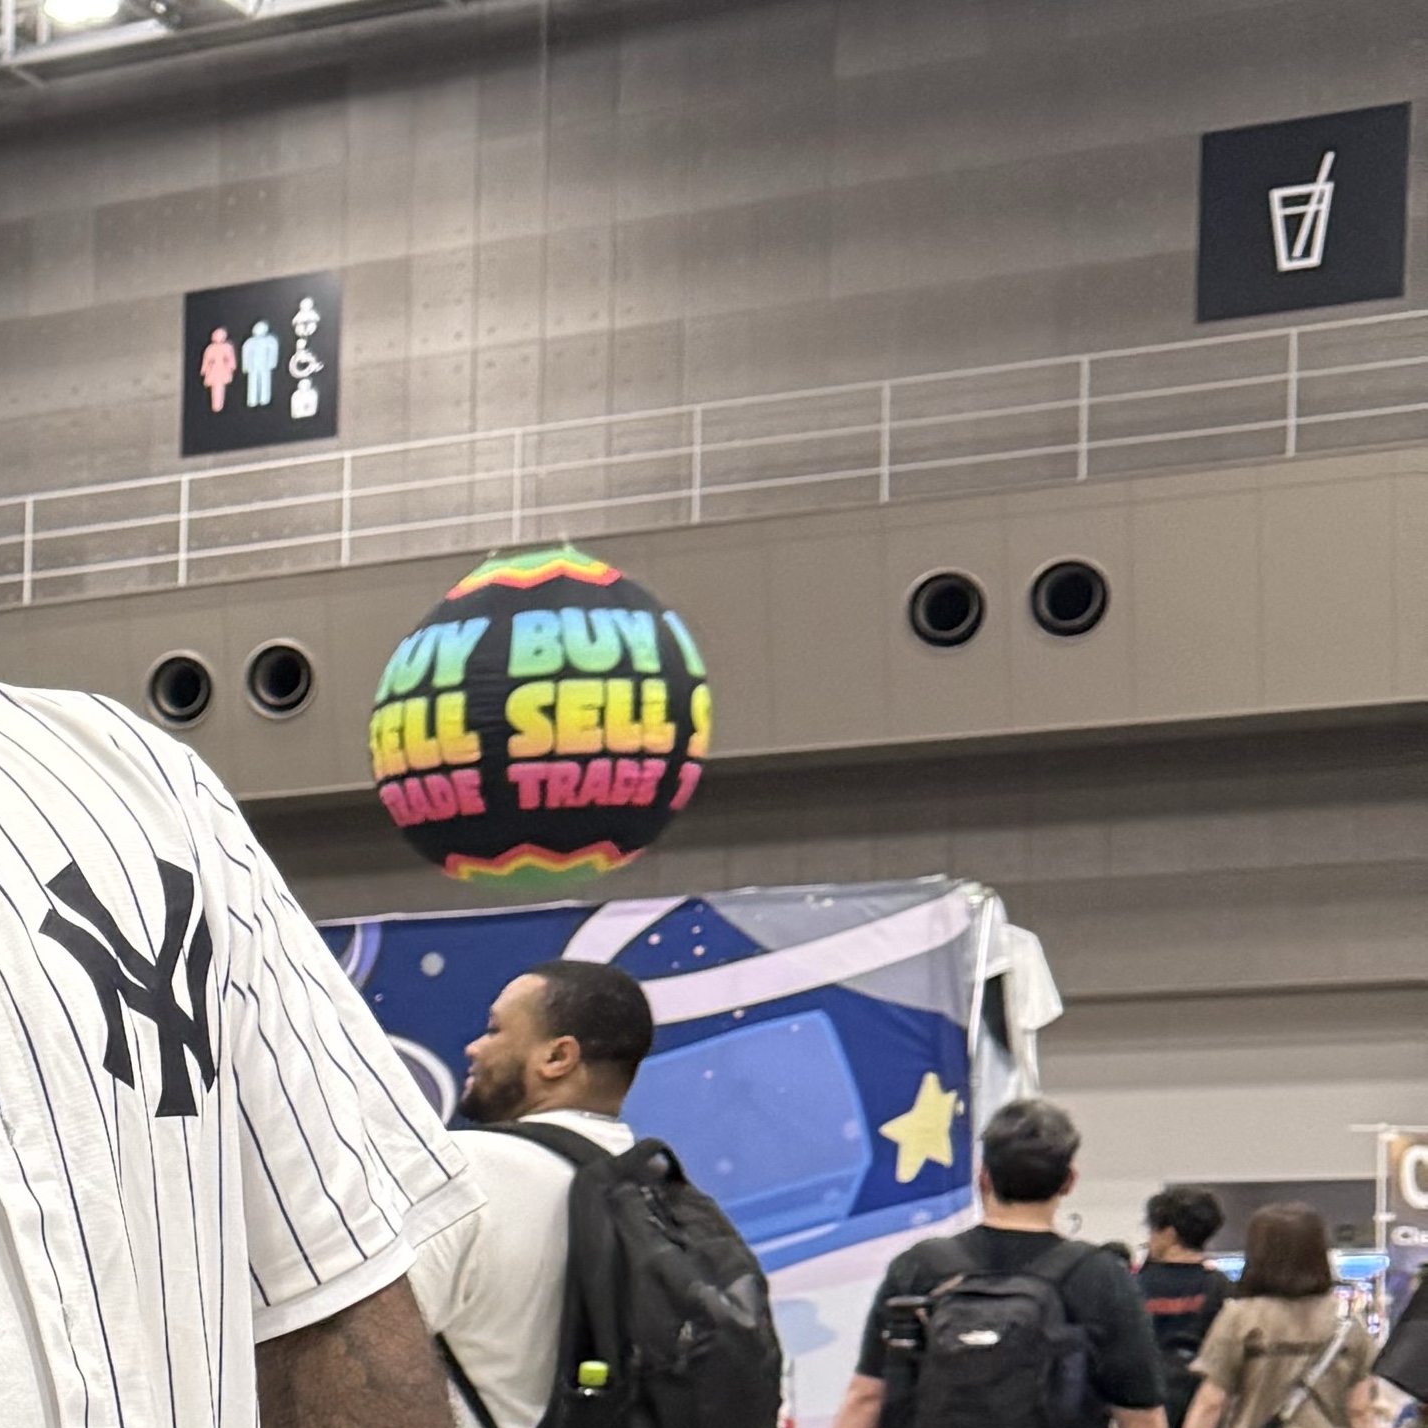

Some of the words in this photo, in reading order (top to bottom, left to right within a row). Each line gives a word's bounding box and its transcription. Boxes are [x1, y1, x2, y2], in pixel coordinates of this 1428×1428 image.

[375, 616, 490, 703] UY
[507, 607, 662, 678] BUY
[369, 690, 482, 781] ELL
[505, 678, 676, 759] SELL
[507, 757, 667, 810] TRADE
[39, 856, 217, 1118] NY
